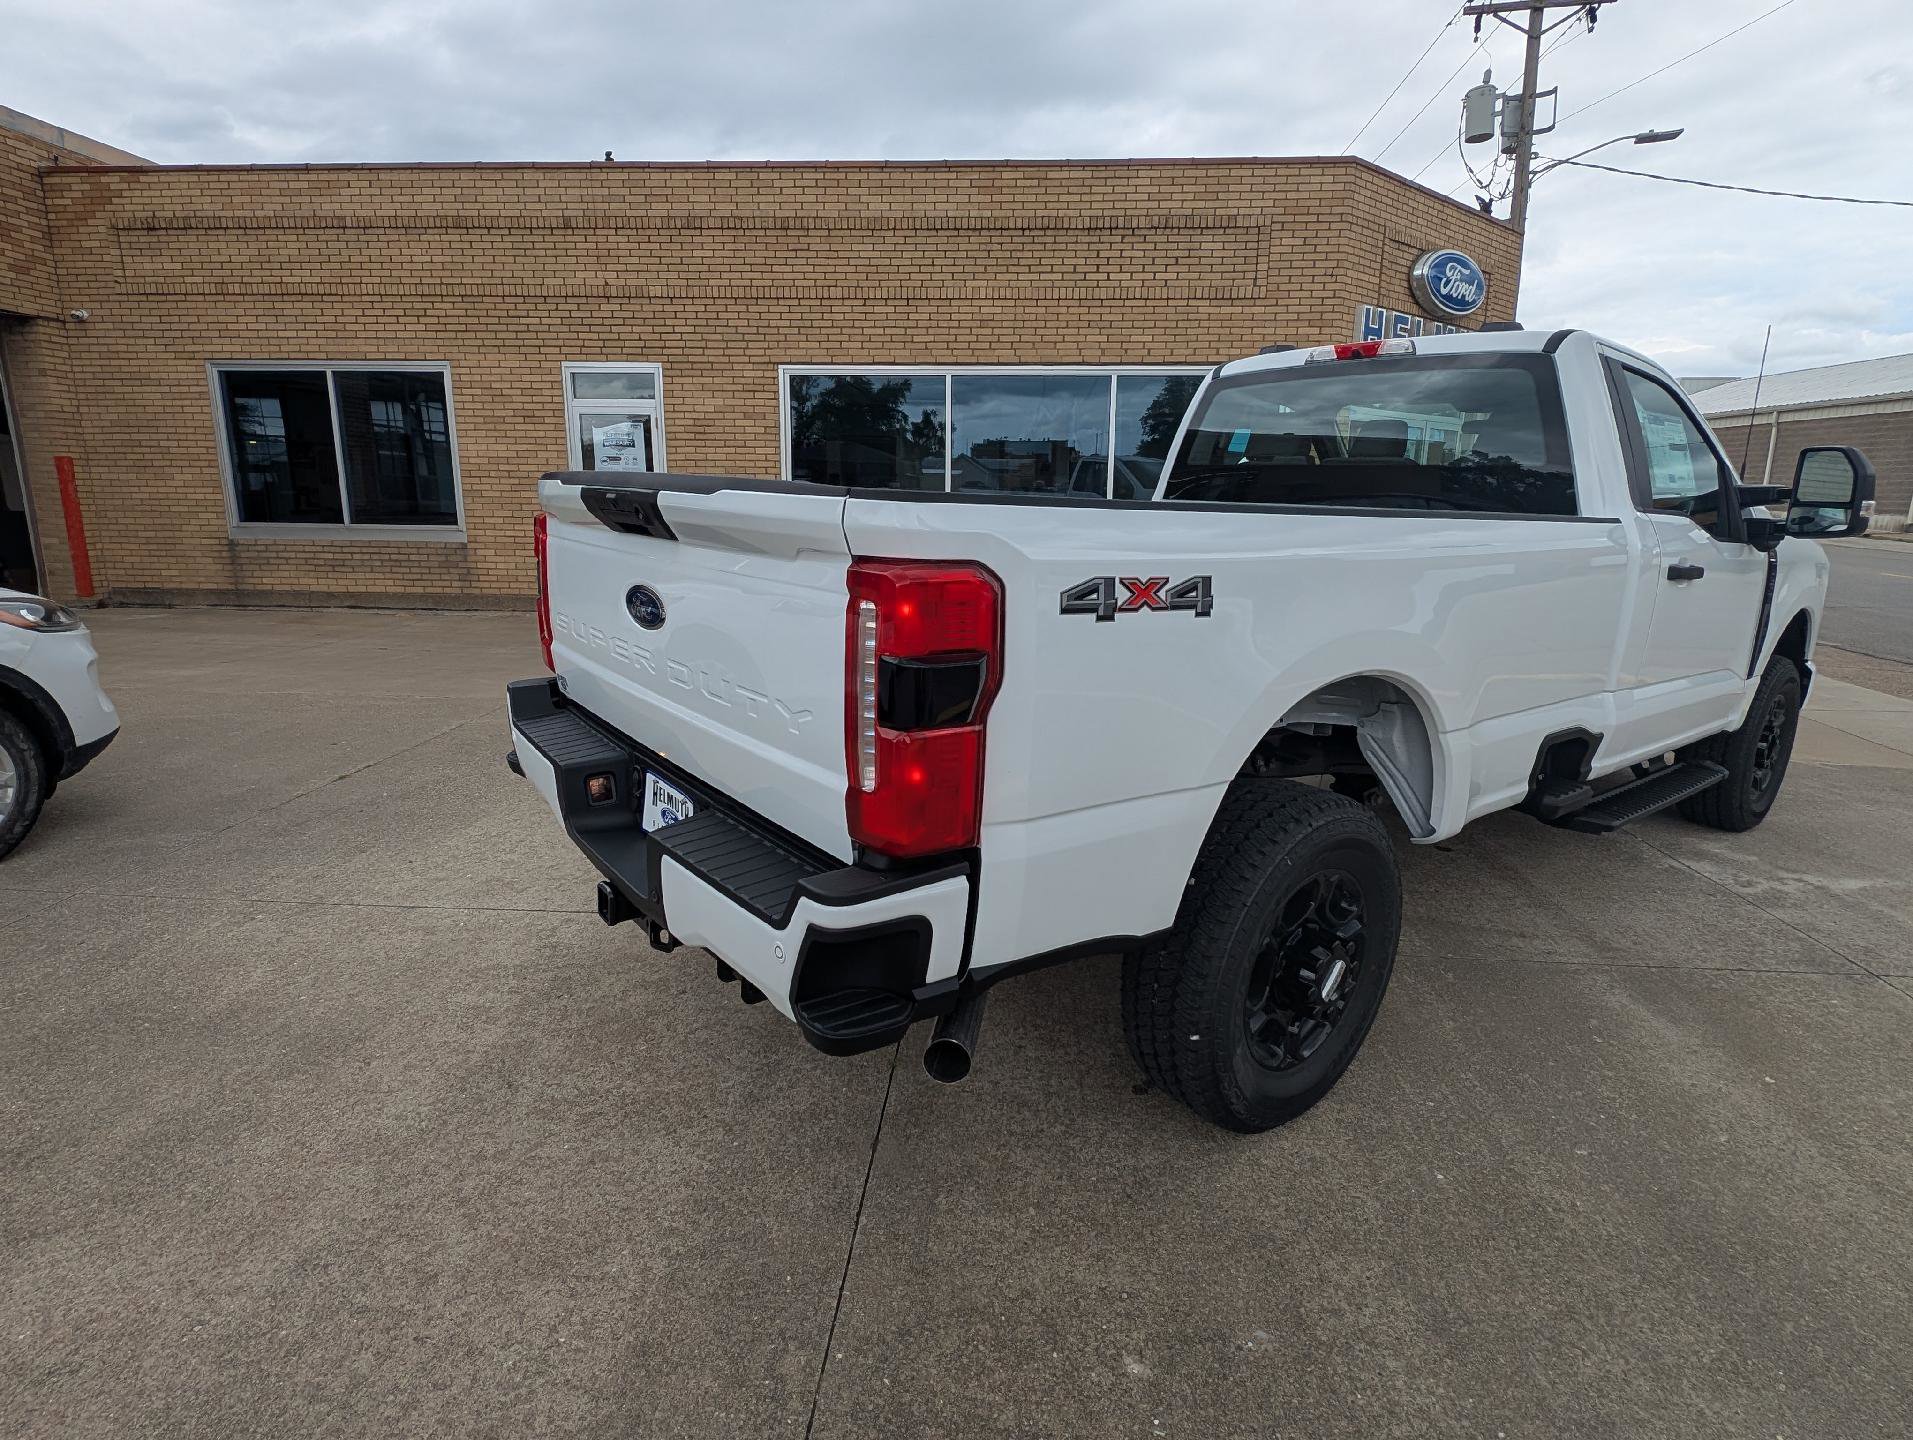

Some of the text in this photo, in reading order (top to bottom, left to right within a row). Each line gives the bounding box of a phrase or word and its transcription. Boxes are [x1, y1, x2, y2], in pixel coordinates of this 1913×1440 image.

[1440, 262, 1477, 303] Ford
[556, 609, 814, 735] SUPER DUTY
[652, 780, 689, 820] HELMUTH
